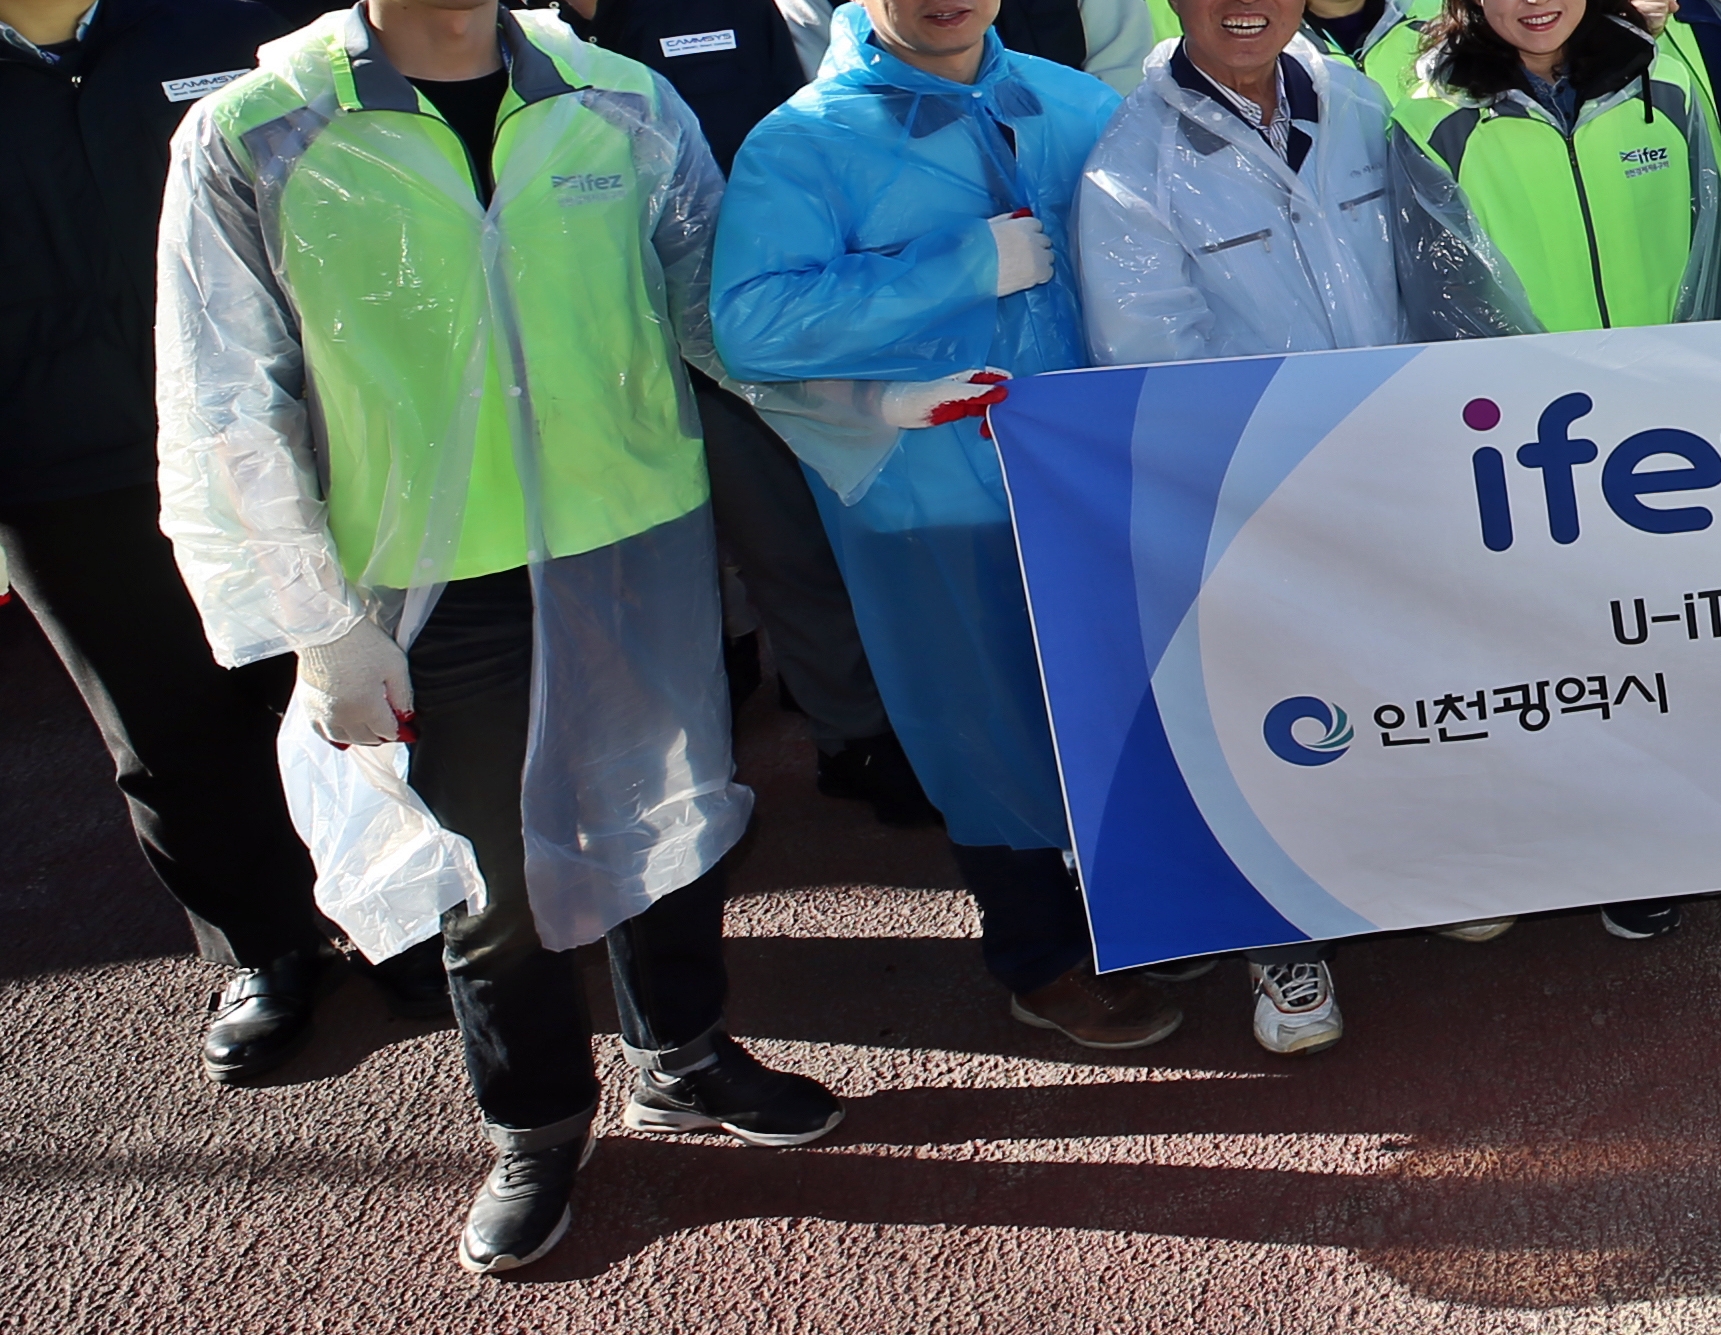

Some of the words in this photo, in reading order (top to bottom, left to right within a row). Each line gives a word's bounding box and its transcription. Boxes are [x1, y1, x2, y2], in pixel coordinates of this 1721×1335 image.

[666, 32, 732, 47] CAMMSYS
[1636, 146, 1669, 164] ifez
[578, 173, 623, 192] ifez
[1372, 672, 1670, 748] 인천광역시
